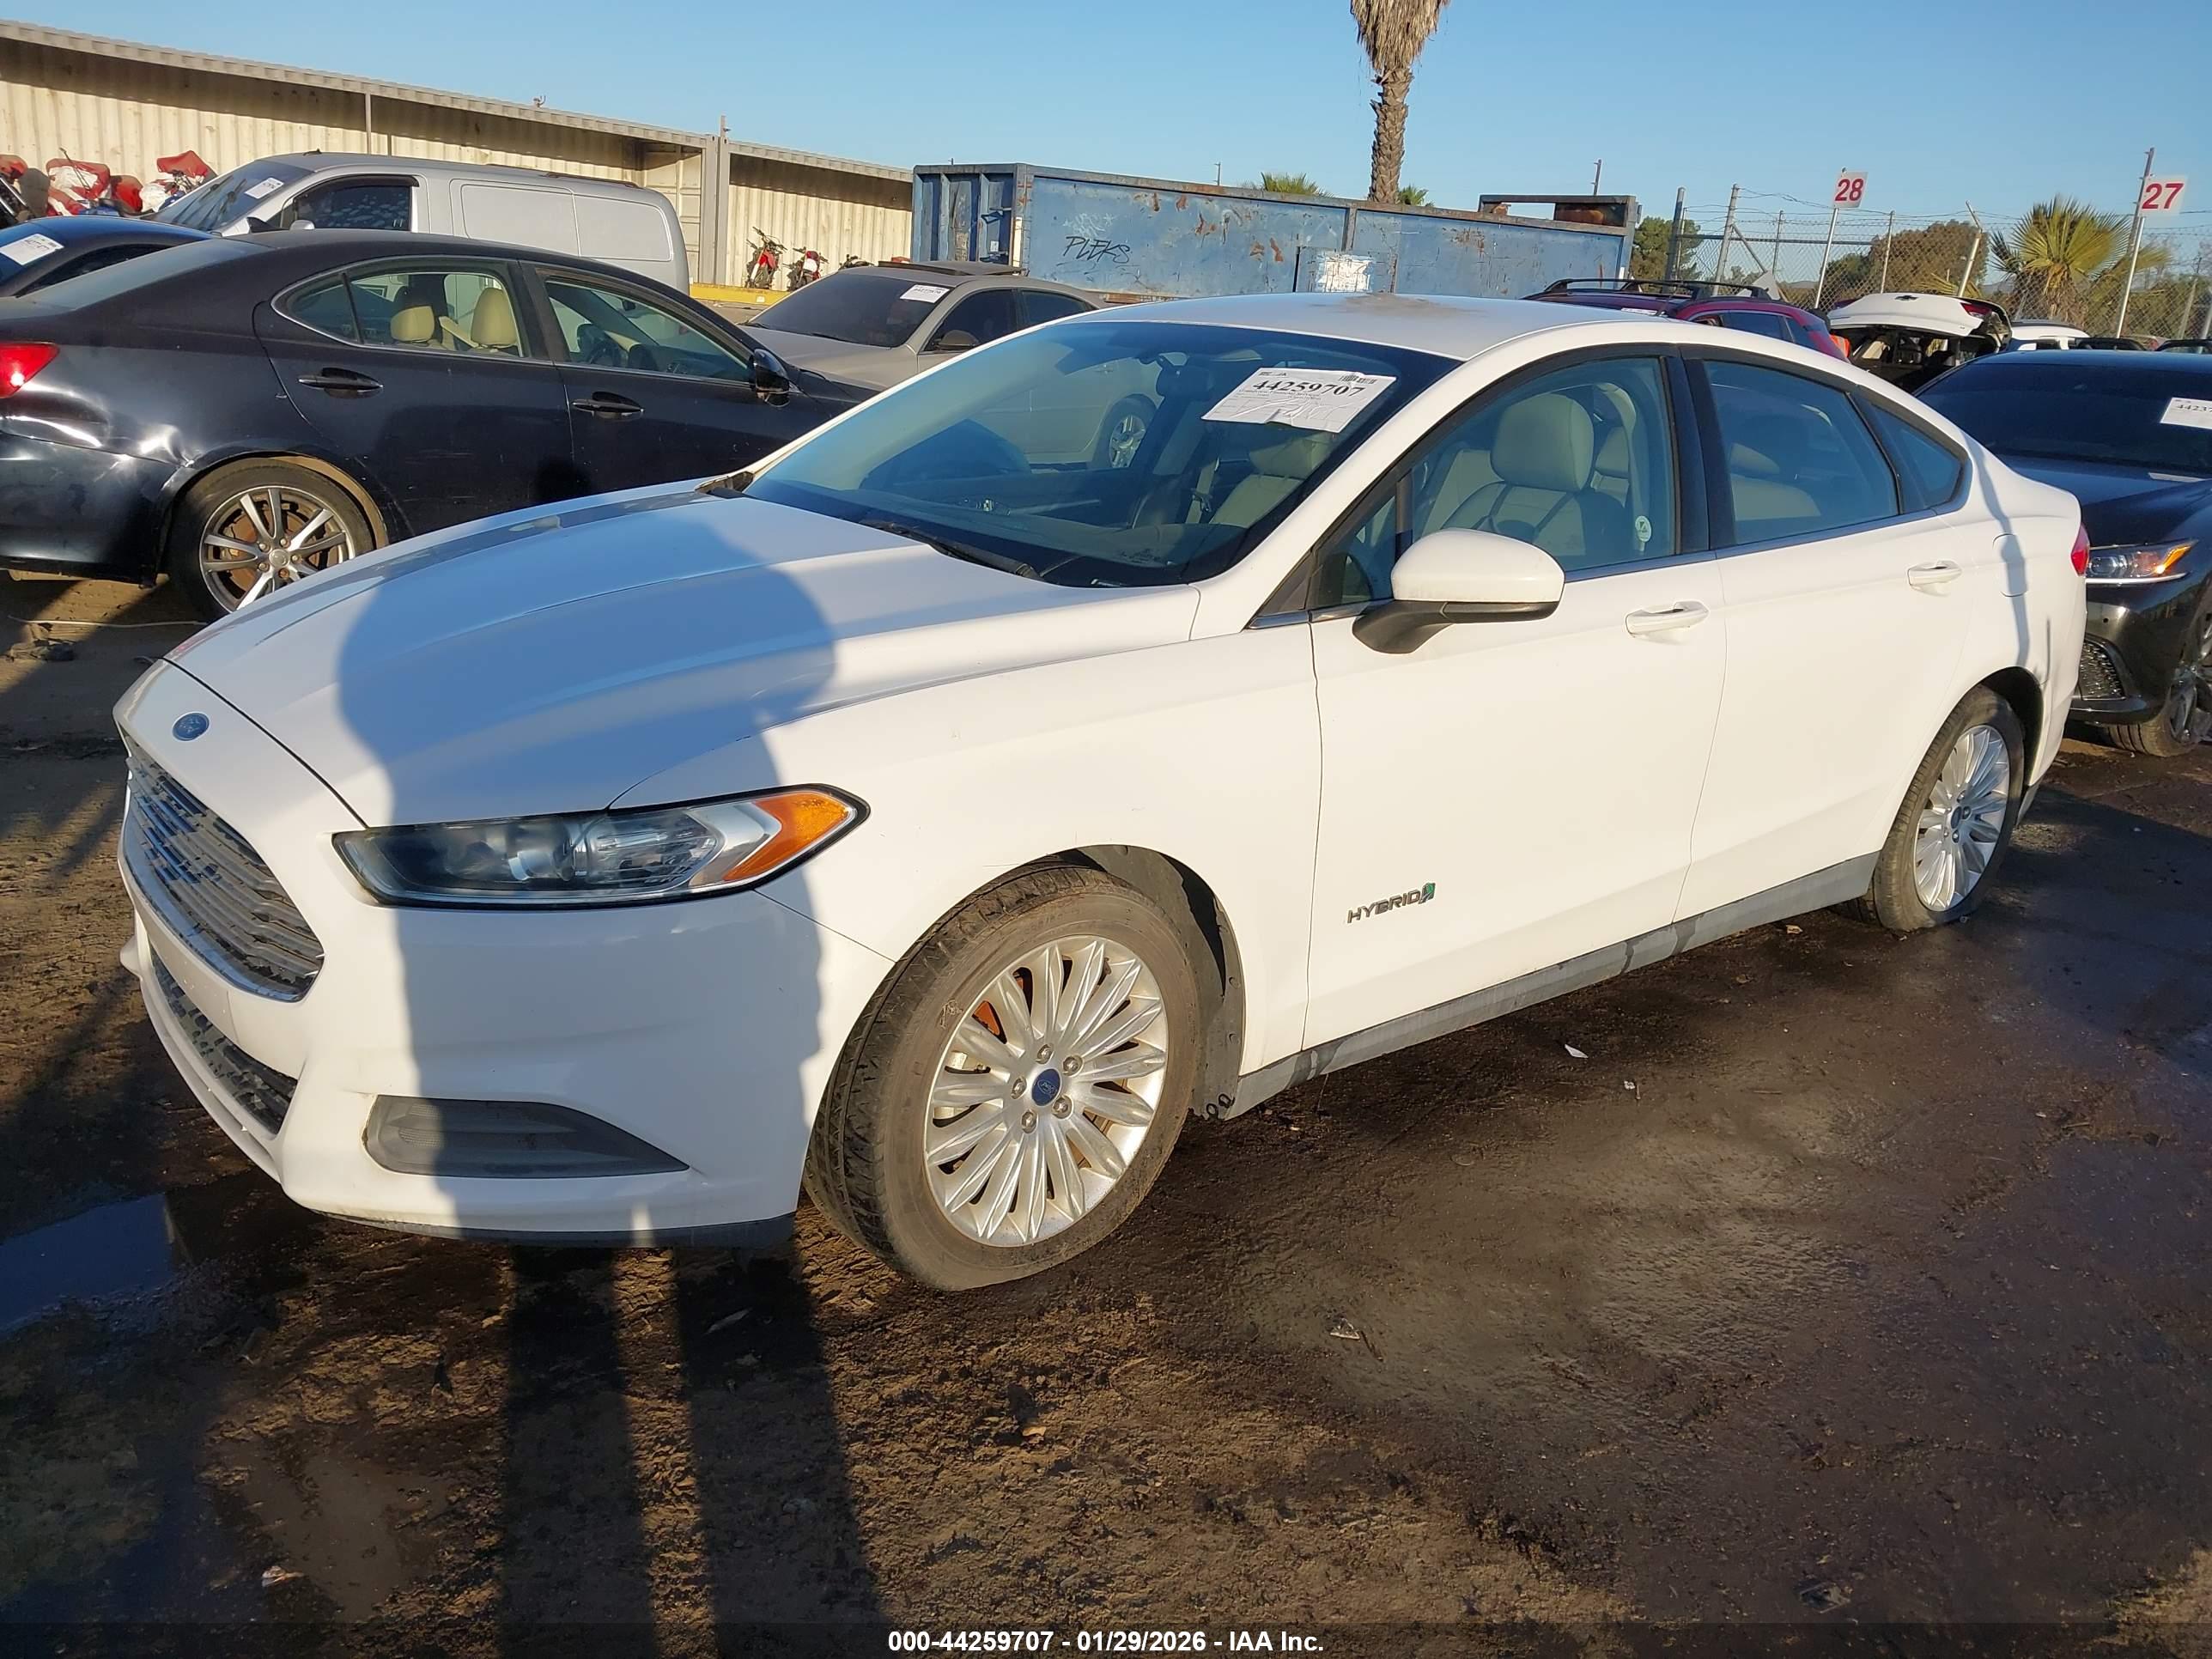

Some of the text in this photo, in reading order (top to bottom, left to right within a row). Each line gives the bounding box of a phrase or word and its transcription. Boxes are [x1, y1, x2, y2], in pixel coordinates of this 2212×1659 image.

[1834, 178, 1864, 202] 28
[2142, 183, 2185, 210] 27
[1253, 380, 1367, 398] 44259707
[1346, 889, 1421, 924] HYBRID
